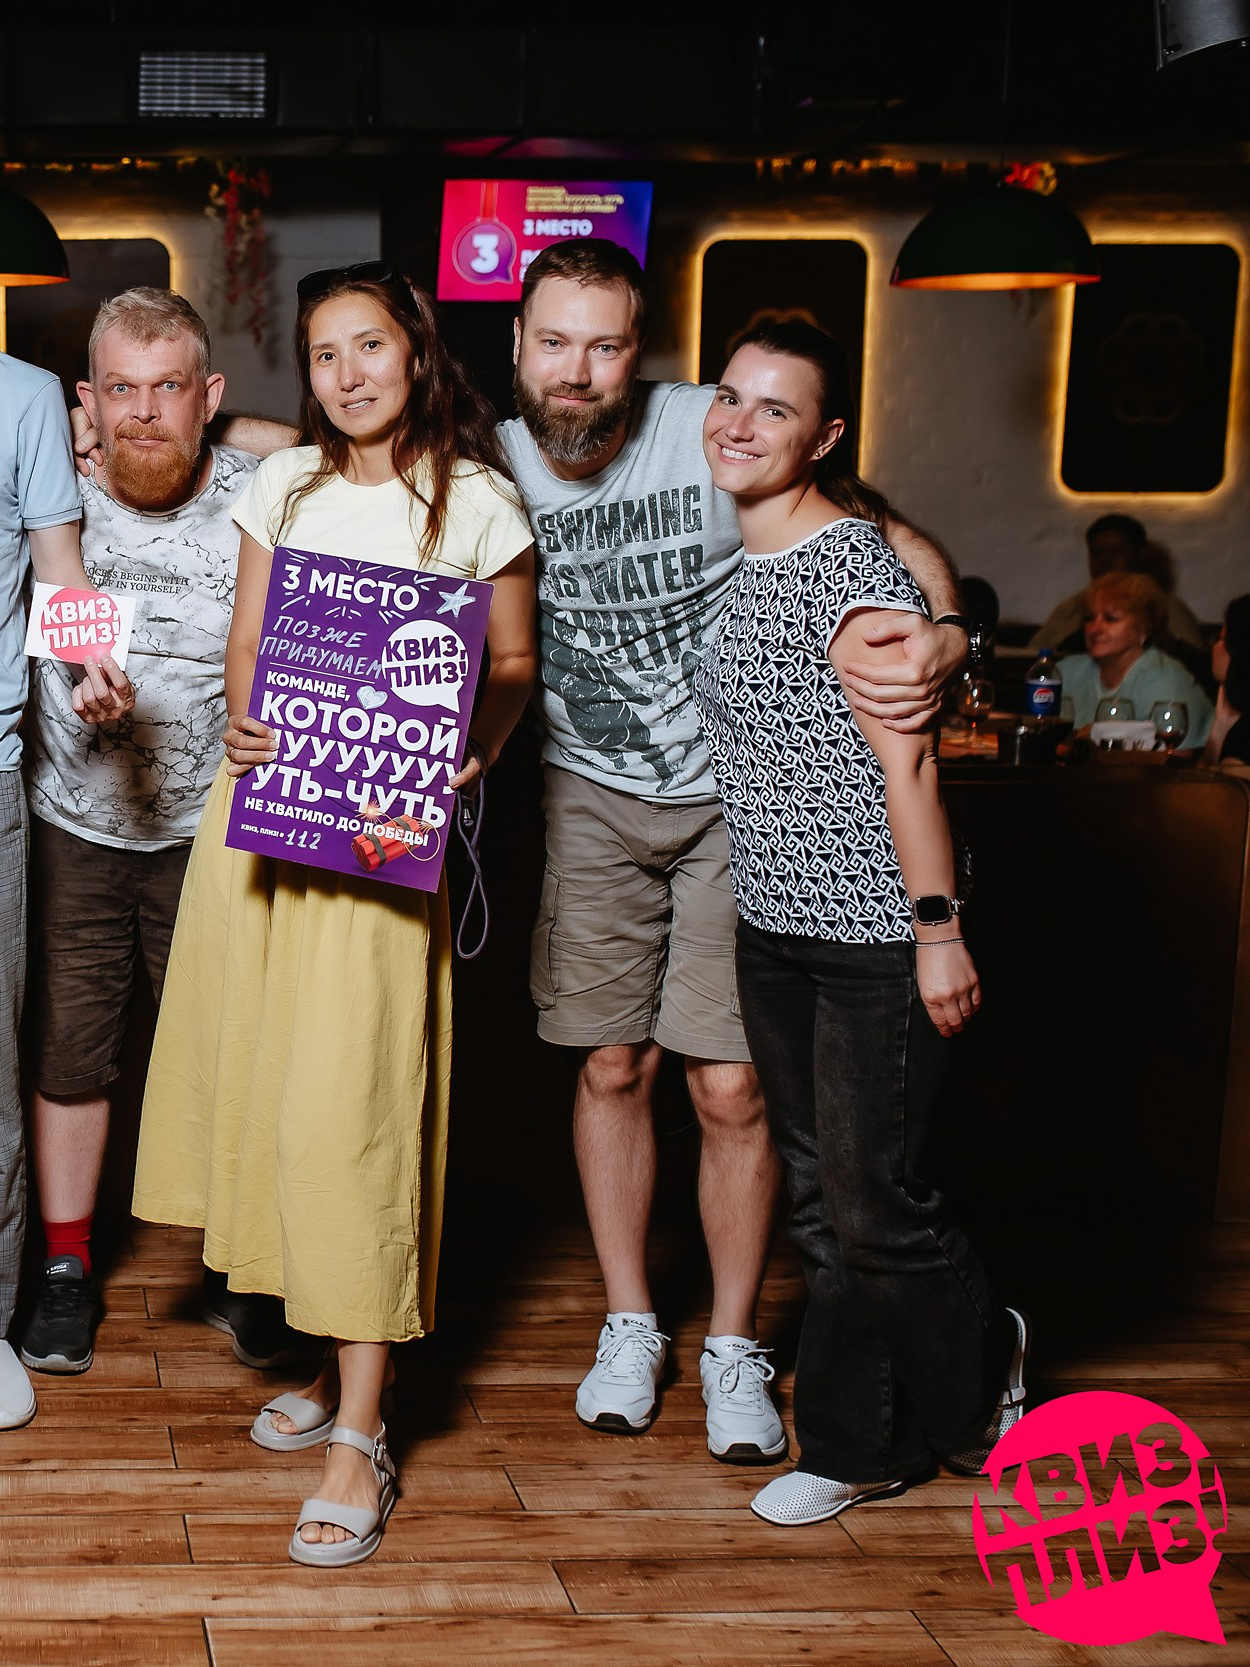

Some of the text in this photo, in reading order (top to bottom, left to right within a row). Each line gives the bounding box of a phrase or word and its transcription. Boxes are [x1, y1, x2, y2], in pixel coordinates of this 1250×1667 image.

[523, 219, 535, 236] 3
[470, 234, 499, 274] 3
[538, 484, 703, 553] SWIMMING
[84, 566, 191, 587] UCCESS BEGINS WITH
[116, 580, 127, 589] IN
[130, 582, 182, 594] YOURSELF
[282, 564, 420, 611] 3 МЕСТО
[549, 544, 705, 605] IS WATER
[273, 615, 367, 648] ПОЗЖЕ
[260, 636, 383, 679] ПРИДУМАЕМ
[266, 670, 350, 701] КОМАНДЕ,
[260, 690, 460, 759] КОТОРОЙ
[251, 762, 447, 828] УТЬ-ЧУТЬ
[244, 796, 429, 847] НЕ ХВАТИЛО ДО ПОБЕДЫ
[285, 828, 322, 850] 112
